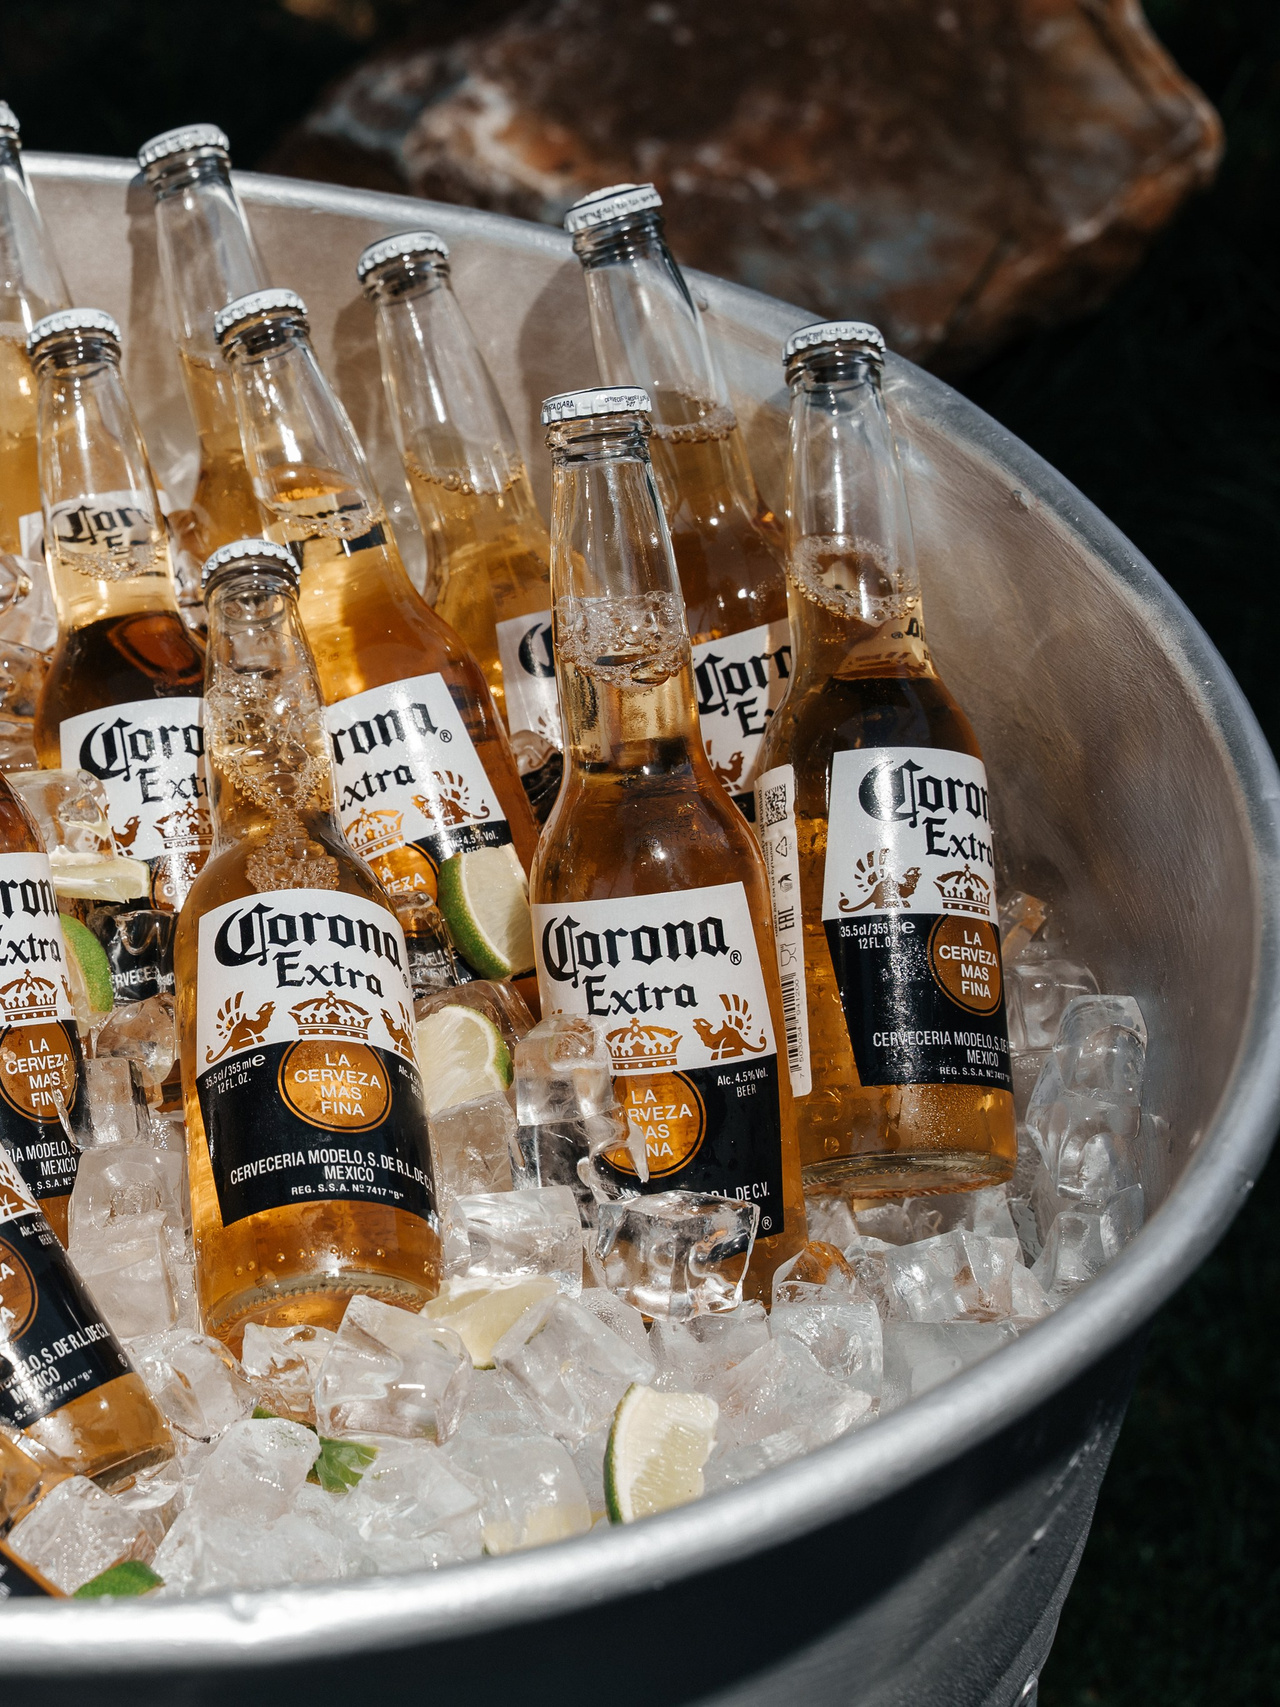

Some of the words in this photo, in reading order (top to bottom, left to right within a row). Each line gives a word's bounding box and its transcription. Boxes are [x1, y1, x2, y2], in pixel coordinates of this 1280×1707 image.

[340, 763, 416, 812] xtra
[483, 830, 499, 841] Vol.
[214, 902, 403, 972] Corona
[964, 930, 982, 946] LA
[542, 915, 731, 989] Corona
[938, 945, 998, 968] CERVEZA
[272, 949, 385, 998] Extra
[960, 965, 990, 981] MAS
[582, 974, 699, 1017] Extra
[961, 980, 992, 999] FINA
[29, 1037, 50, 1054] LA
[872, 1030, 952, 1047] CERVECERIA
[5, 1053, 70, 1076] CERVEZA
[325, 1053, 350, 1067] LA
[966, 1049, 999, 1067] MEXICO
[294, 1069, 382, 1089] CERVEZA
[717, 1075, 734, 1087] Alc.
[735, 1069, 755, 1084] 4.5%
[755, 1067, 769, 1080] Vol.
[939, 1066, 961, 1075] REG.
[29, 1071, 62, 1090] MAS
[320, 1085, 363, 1100] MAS
[631, 1089, 657, 1104] LA
[736, 1084, 757, 1098] BEER
[321, 1101, 366, 1117] FINA
[642, 1125, 671, 1140] AS
[40, 1156, 77, 1177] MEXICO
[230, 1151, 305, 1186] CERVECERIA
[308, 1149, 367, 1166] MODELO,
[368, 1152, 380, 1168] S.
[380, 1154, 396, 1172] DE
[396, 1159, 414, 1179] R.L.
[414, 1167, 425, 1186] DE
[324, 1165, 375, 1182] MEXICO
[291, 1185, 315, 1196] REG.
[317, 1183, 350, 1193] S.S.A.
[366, 1186, 387, 1197] 7417
[735, 1184, 752, 1201] DE
[753, 1181, 770, 1199] C.V.
[41, 1347, 58, 1363] S.
[52, 1337, 73, 1358] DE
[9, 1366, 61, 1405] MXICO
[57, 1377, 78, 1395] 7417
